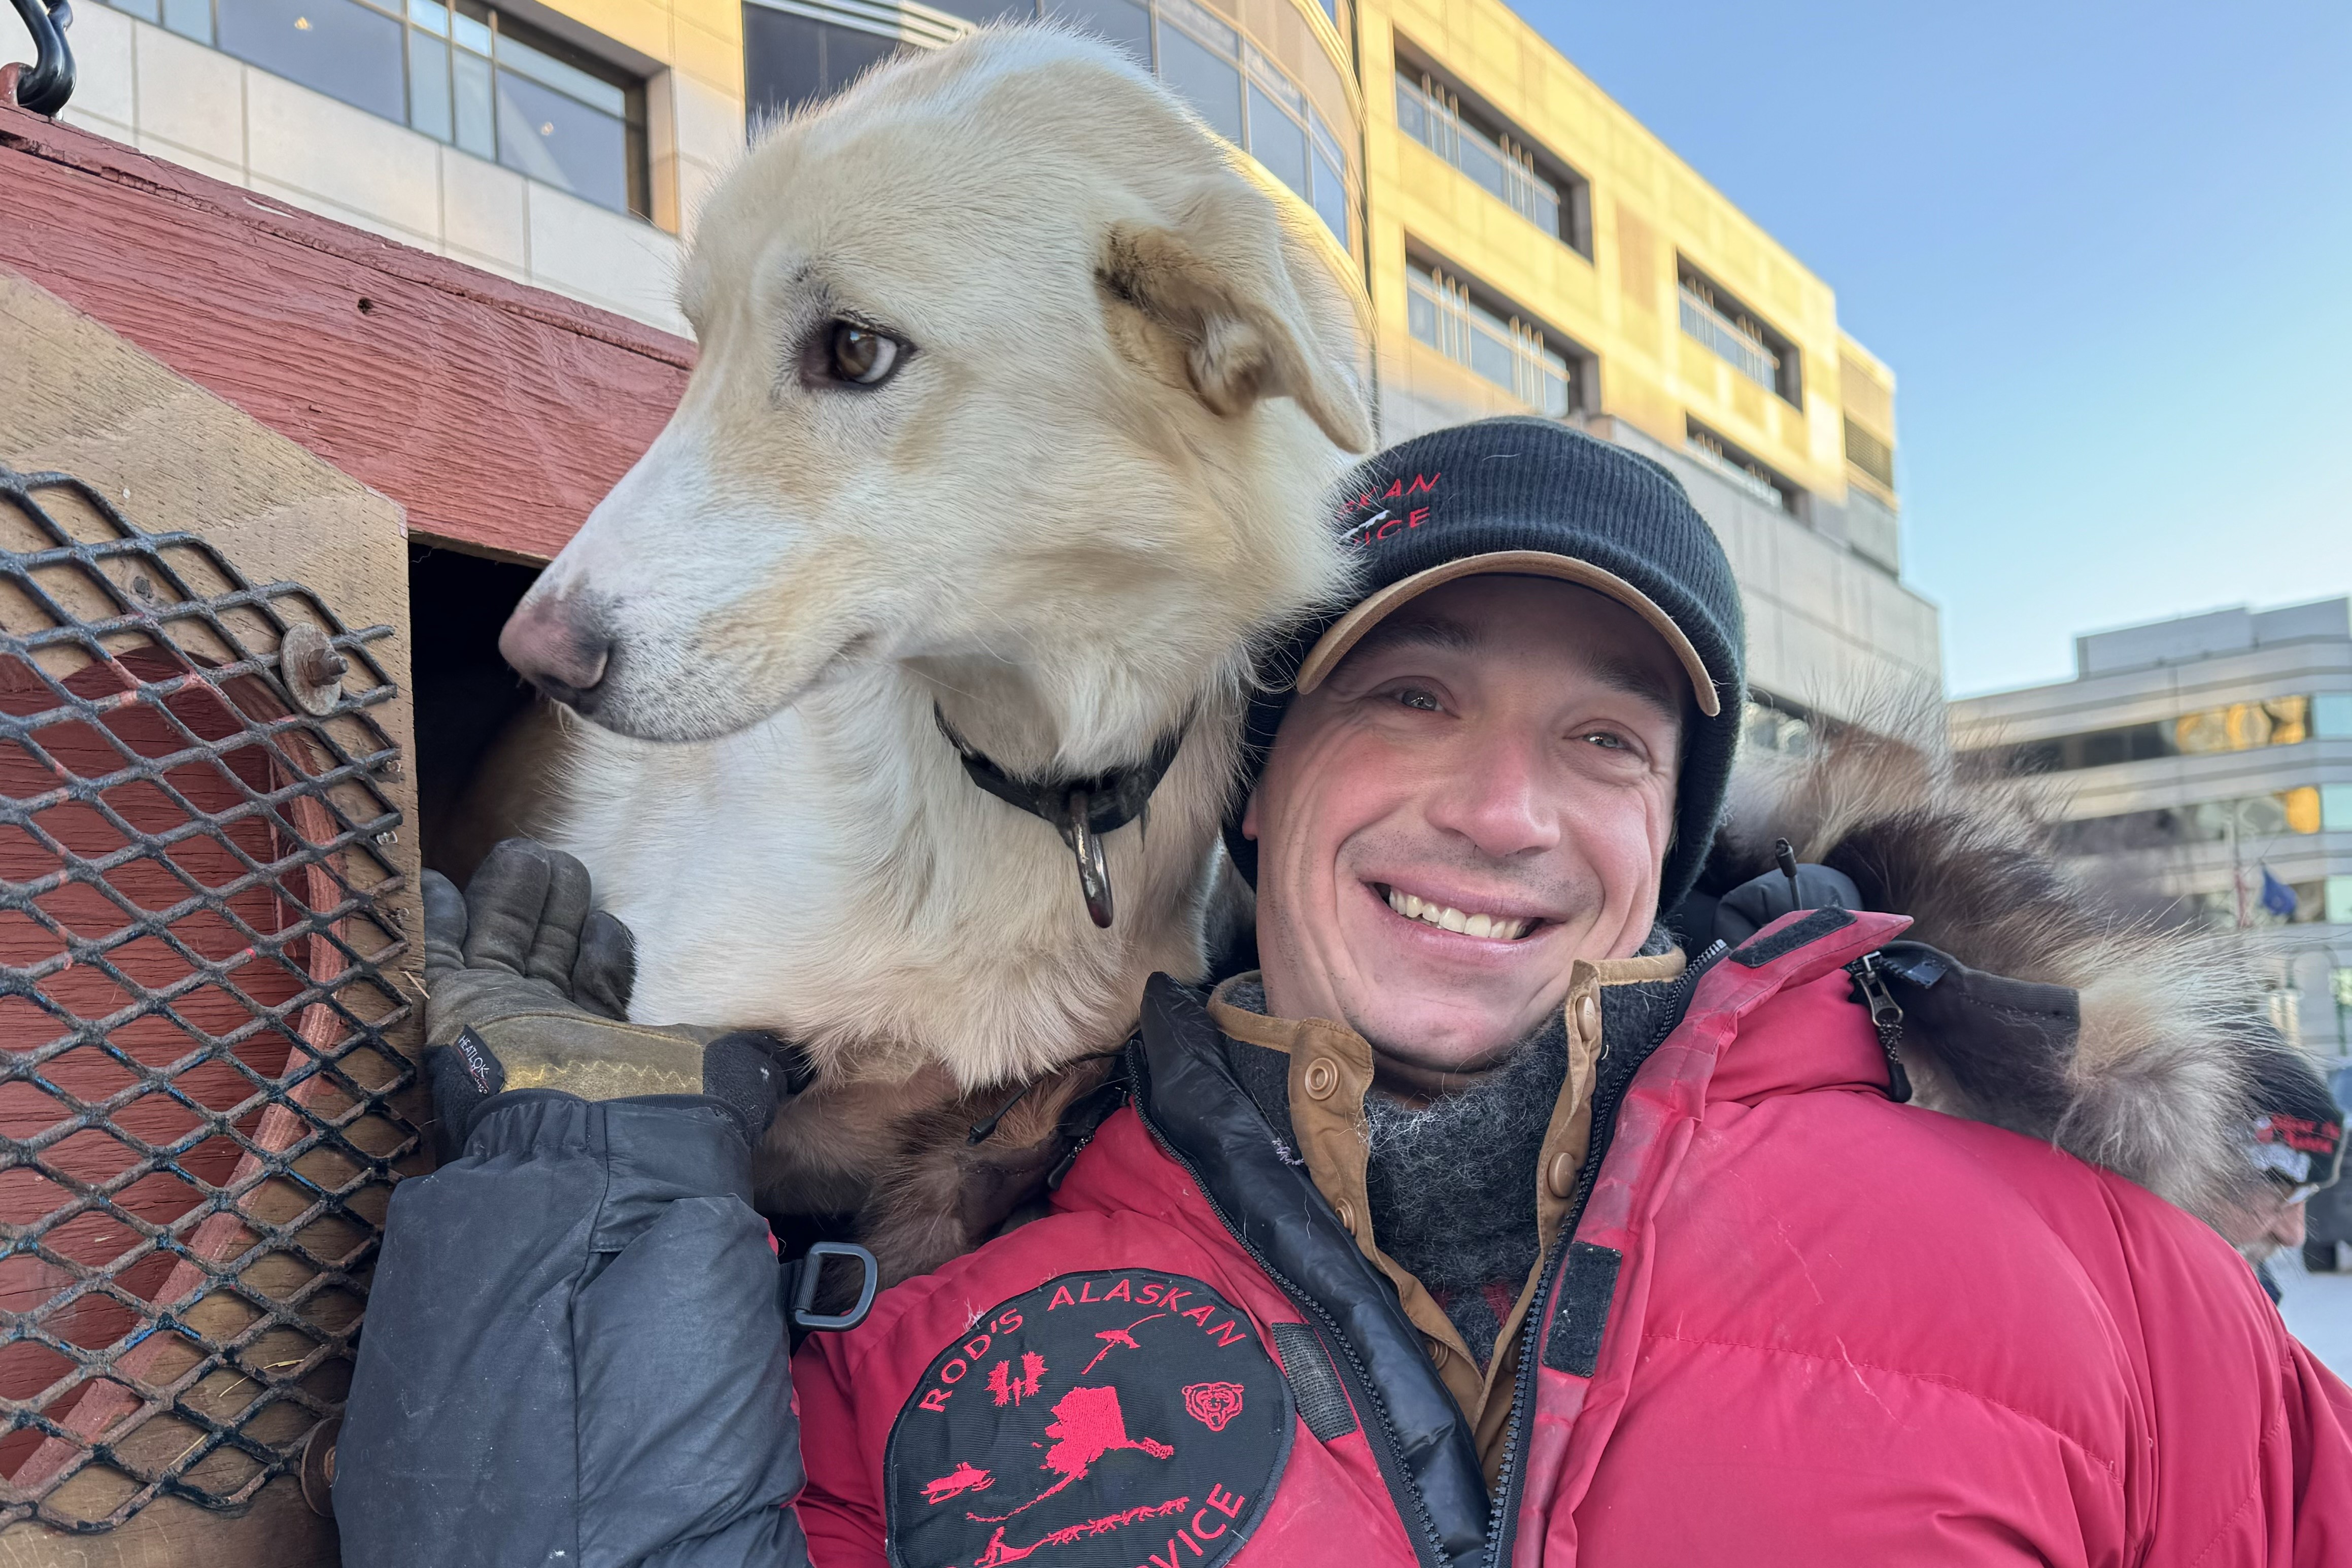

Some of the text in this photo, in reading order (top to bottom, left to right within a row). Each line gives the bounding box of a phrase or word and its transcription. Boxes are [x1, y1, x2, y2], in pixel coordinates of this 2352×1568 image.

[1353, 506, 1430, 546] ICE
[458, 1035, 490, 1078] HEATLOK
[918, 1279, 1247, 1412] ROD'S ALASKAN
[1135, 1483, 1245, 1568] VICE
